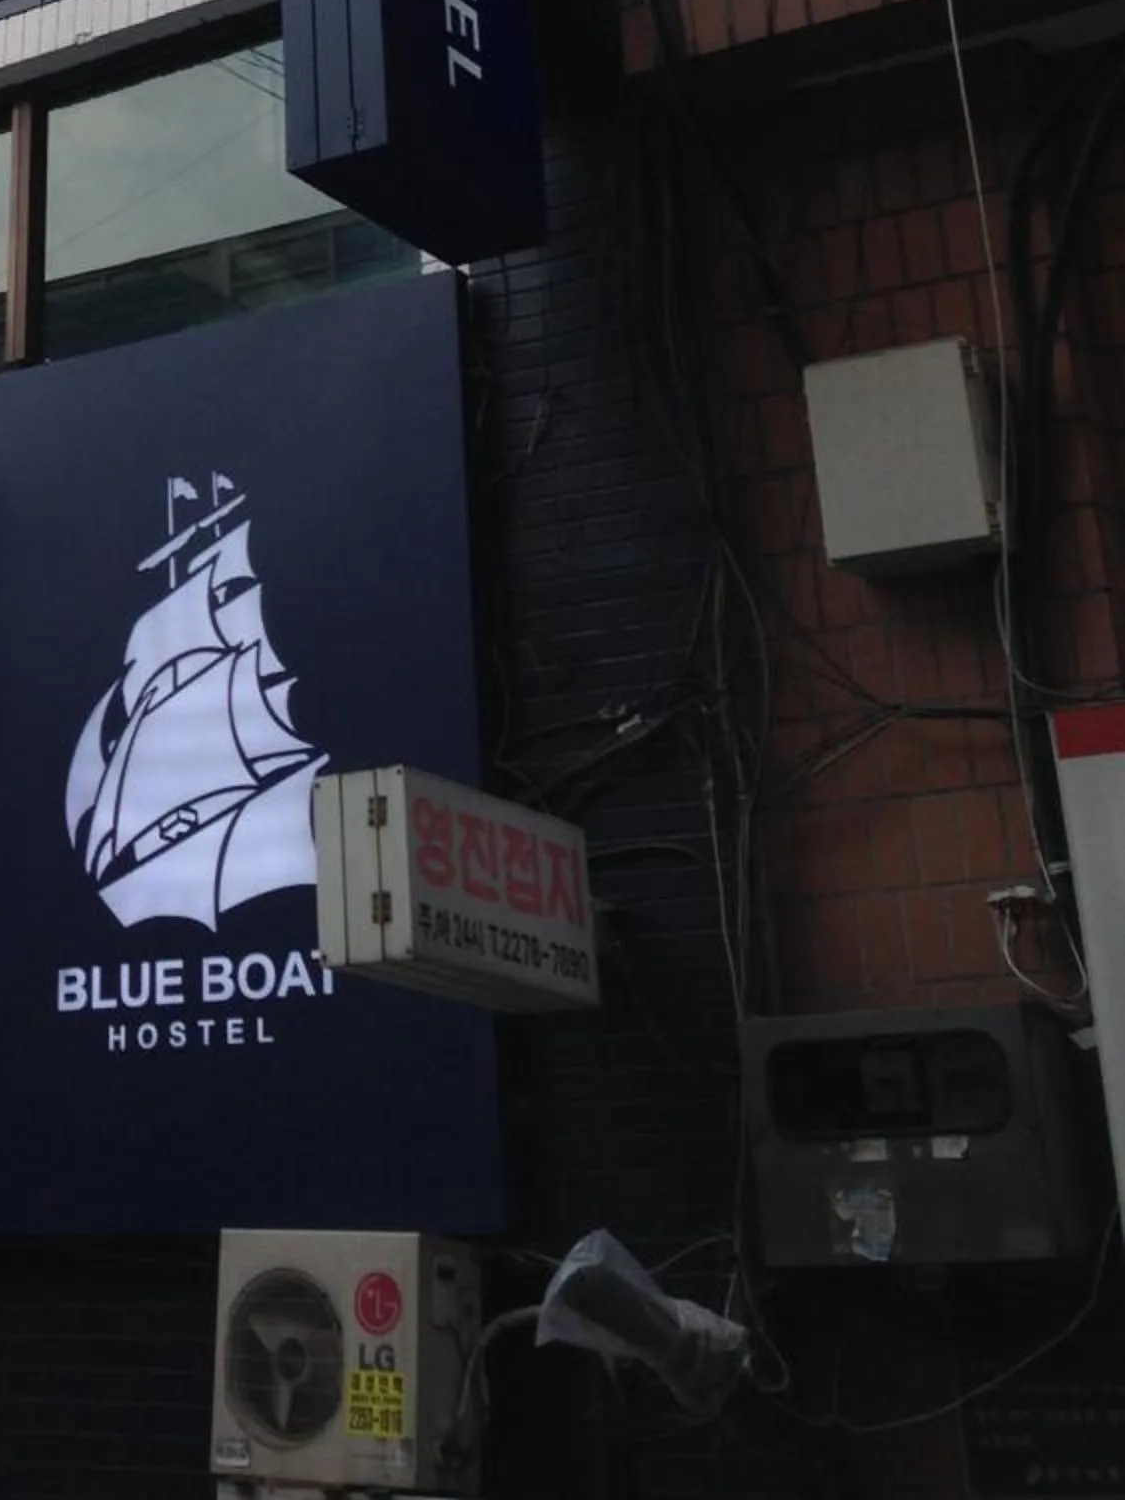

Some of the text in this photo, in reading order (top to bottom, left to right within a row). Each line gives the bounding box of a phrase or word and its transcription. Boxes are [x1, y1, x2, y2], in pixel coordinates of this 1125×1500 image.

[413, 796, 585, 927] 영진접지
[57, 959, 186, 1012] BLUE
[108, 1017, 275, 1052] HOSTEL
[358, 1342, 396, 1372] LG
